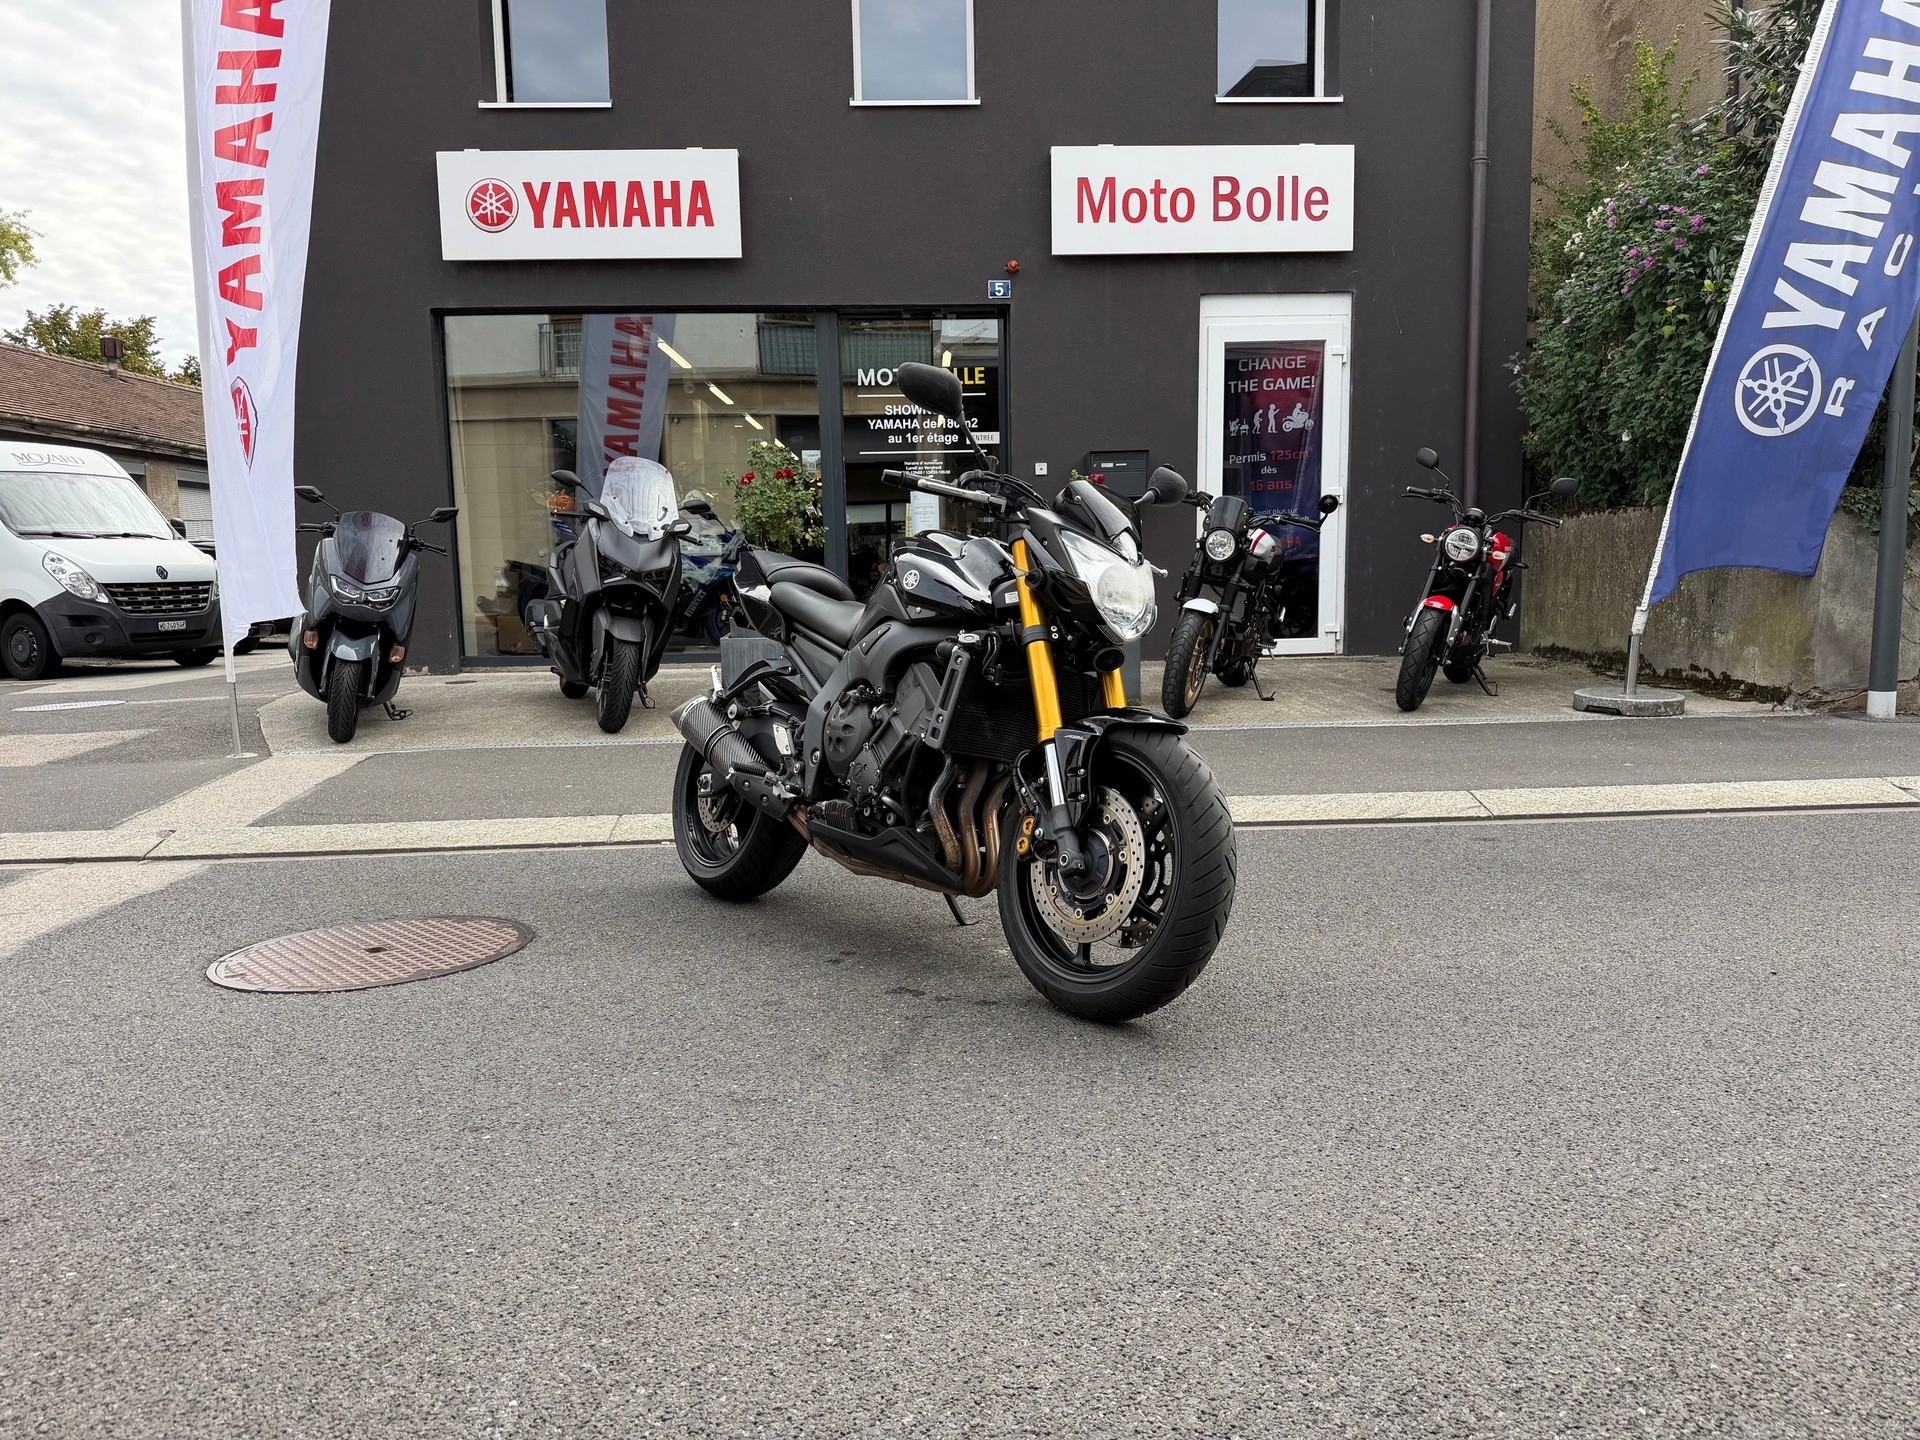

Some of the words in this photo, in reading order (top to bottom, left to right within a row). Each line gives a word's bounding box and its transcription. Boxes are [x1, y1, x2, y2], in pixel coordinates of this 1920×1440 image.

[1762, 0, 1920, 330] YAMAH
[215, 0, 284, 366] YAMAHA
[522, 180, 715, 228] YAMAHA
[1077, 177, 1196, 223] Moto
[1212, 175, 1329, 222] Bolle
[994, 282, 1005, 296] 5
[1238, 355, 1306, 372] CHANGE
[857, 368, 899, 386] MO
[1228, 378, 1259, 394] THE
[1263, 375, 1315, 391] GAME!
[884, 404, 936, 416] SHOW
[867, 419, 920, 430] YAMAHA
[922, 419, 937, 429] de
[888, 434, 902, 444] au
[905, 432, 923, 443] 1er
[926, 432, 959, 445] étage
[11, 453, 85, 467] MOYARD
[1229, 451, 1267, 465] Permis
[1261, 466, 1277, 475] dès
[1249, 480, 1264, 491] 16
[1267, 480, 1293, 490] ans
